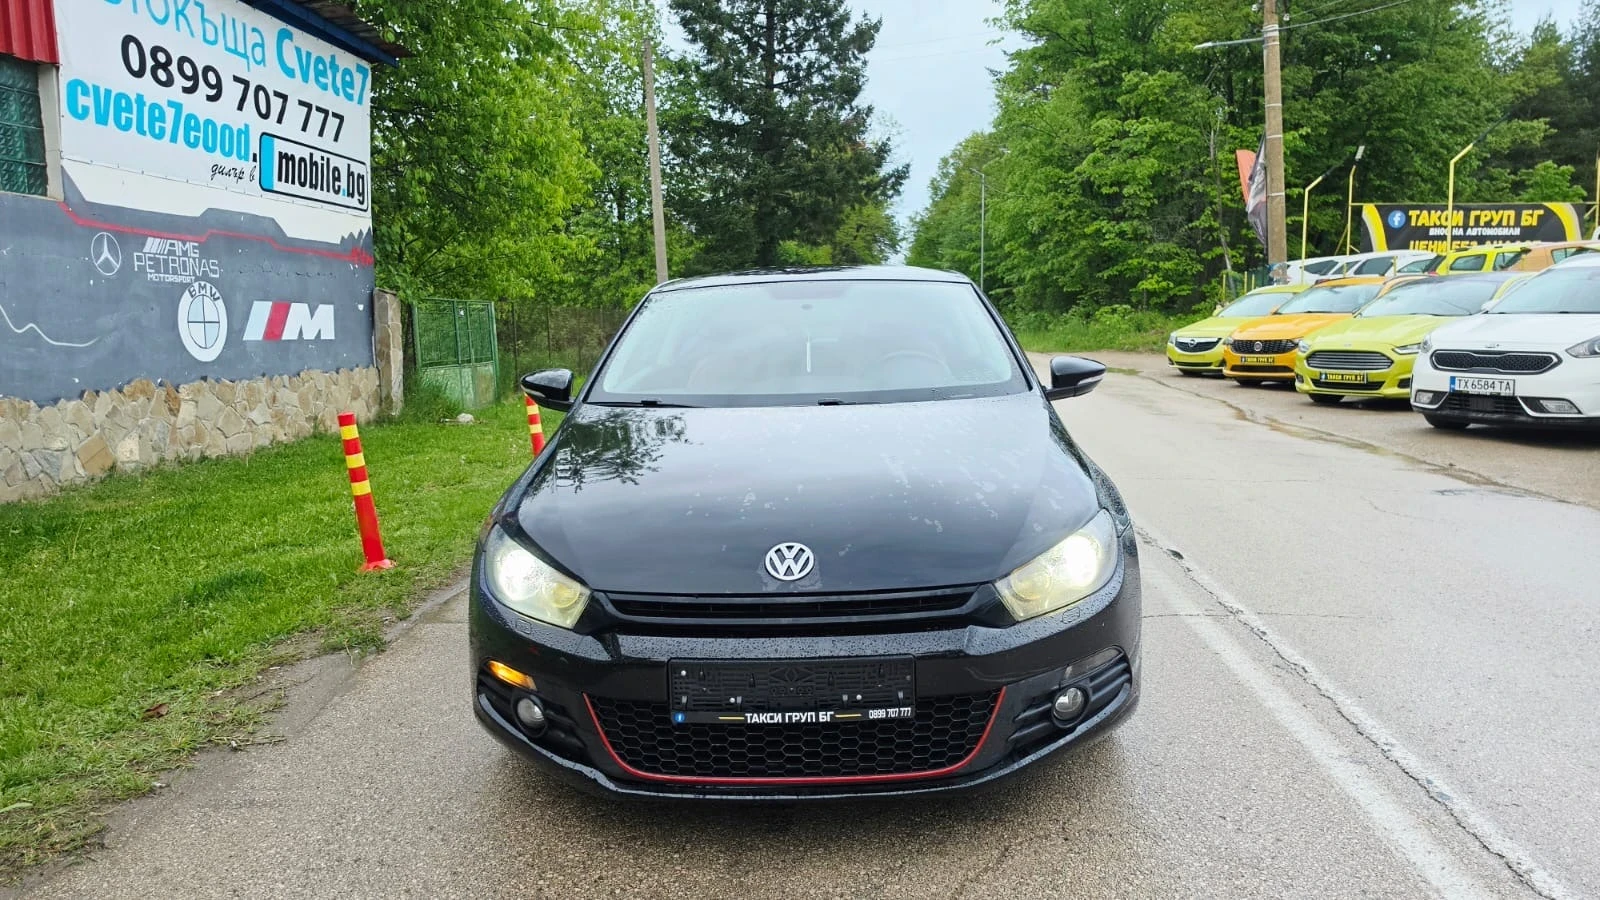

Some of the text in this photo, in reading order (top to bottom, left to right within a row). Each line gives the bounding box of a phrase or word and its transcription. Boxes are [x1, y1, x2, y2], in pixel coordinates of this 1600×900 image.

[275, 28, 370, 107] Cvete7
[121, 34, 345, 143] 0899 707 777
[277, 147, 366, 205] mobile.bg
[1408, 209, 1464, 227] ТАКСИ
[1469, 209, 1516, 227] ГРУП
[1520, 209, 1545, 227] БГ
[1452, 227, 1464, 236] НА
[1465, 227, 1521, 237] АВТОМОБИЛИ
[164, 239, 200, 258] AMG
[133, 252, 220, 278] PETRONAS
[147, 273, 196, 284] MOTORSPORT
[187, 282, 221, 301] BMW
[1457, 379, 1511, 392] TX 6584 TA
[744, 711, 835, 724] ТАКСИ ГРУП БГ
[868, 706, 912, 719] 0899 707 777
